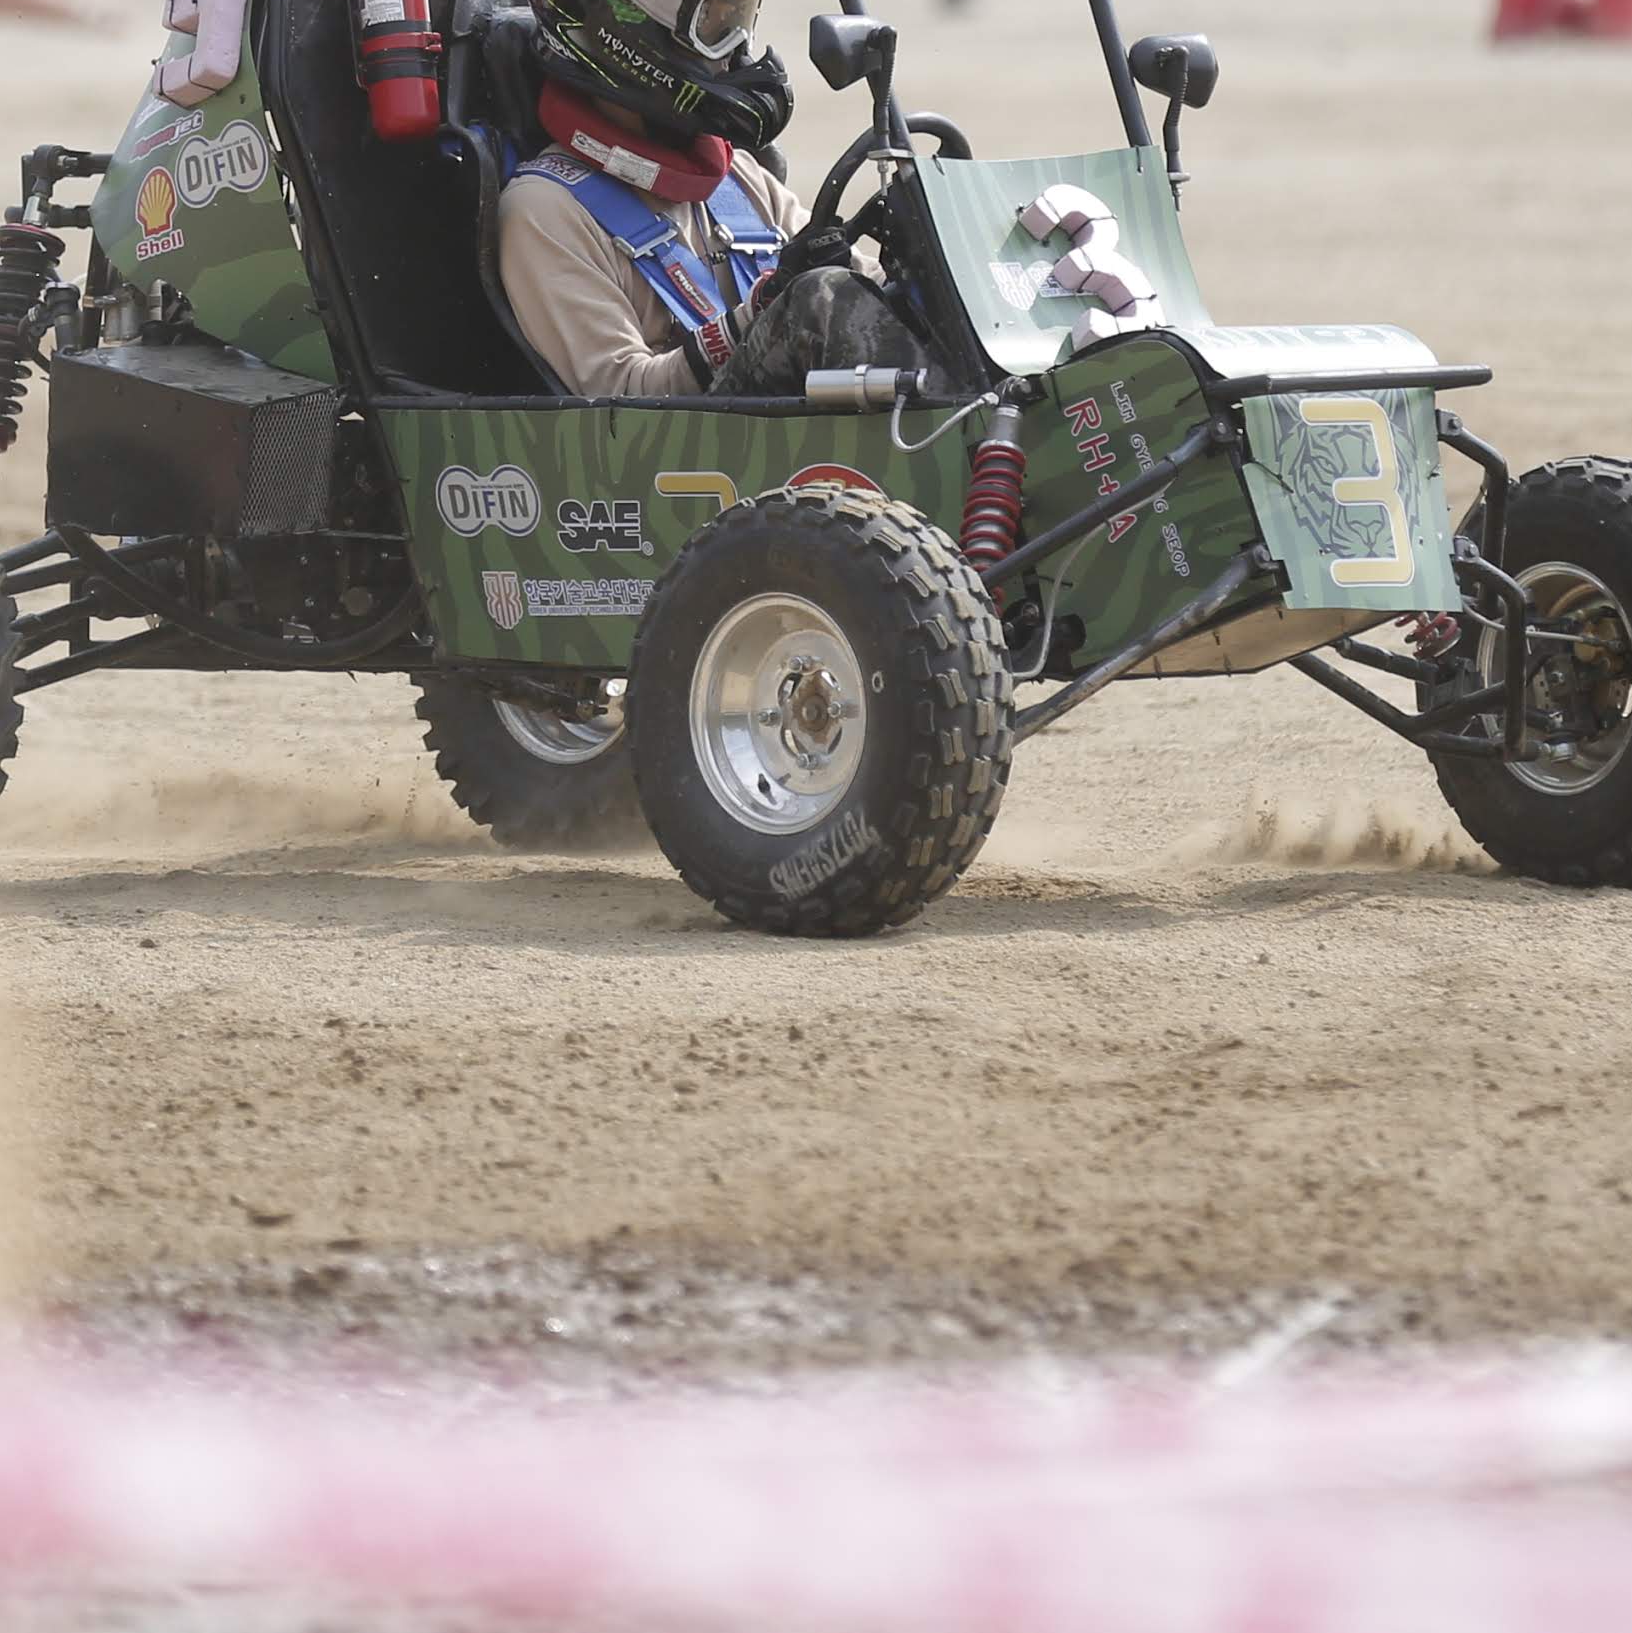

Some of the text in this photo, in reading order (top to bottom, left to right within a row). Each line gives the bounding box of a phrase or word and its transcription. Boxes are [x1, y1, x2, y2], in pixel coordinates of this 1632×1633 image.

[597, 27, 676, 89] MONSTER
[185, 143, 258, 193] DIFIN
[136, 230, 184, 260] Shell
[447, 484, 530, 519] DIFIN
[1110, 380, 1137, 424] LIM
[1162, 523, 1190, 577] SEOP
[1299, 398, 1415, 587] 3
[557, 499, 642, 553] SAE
